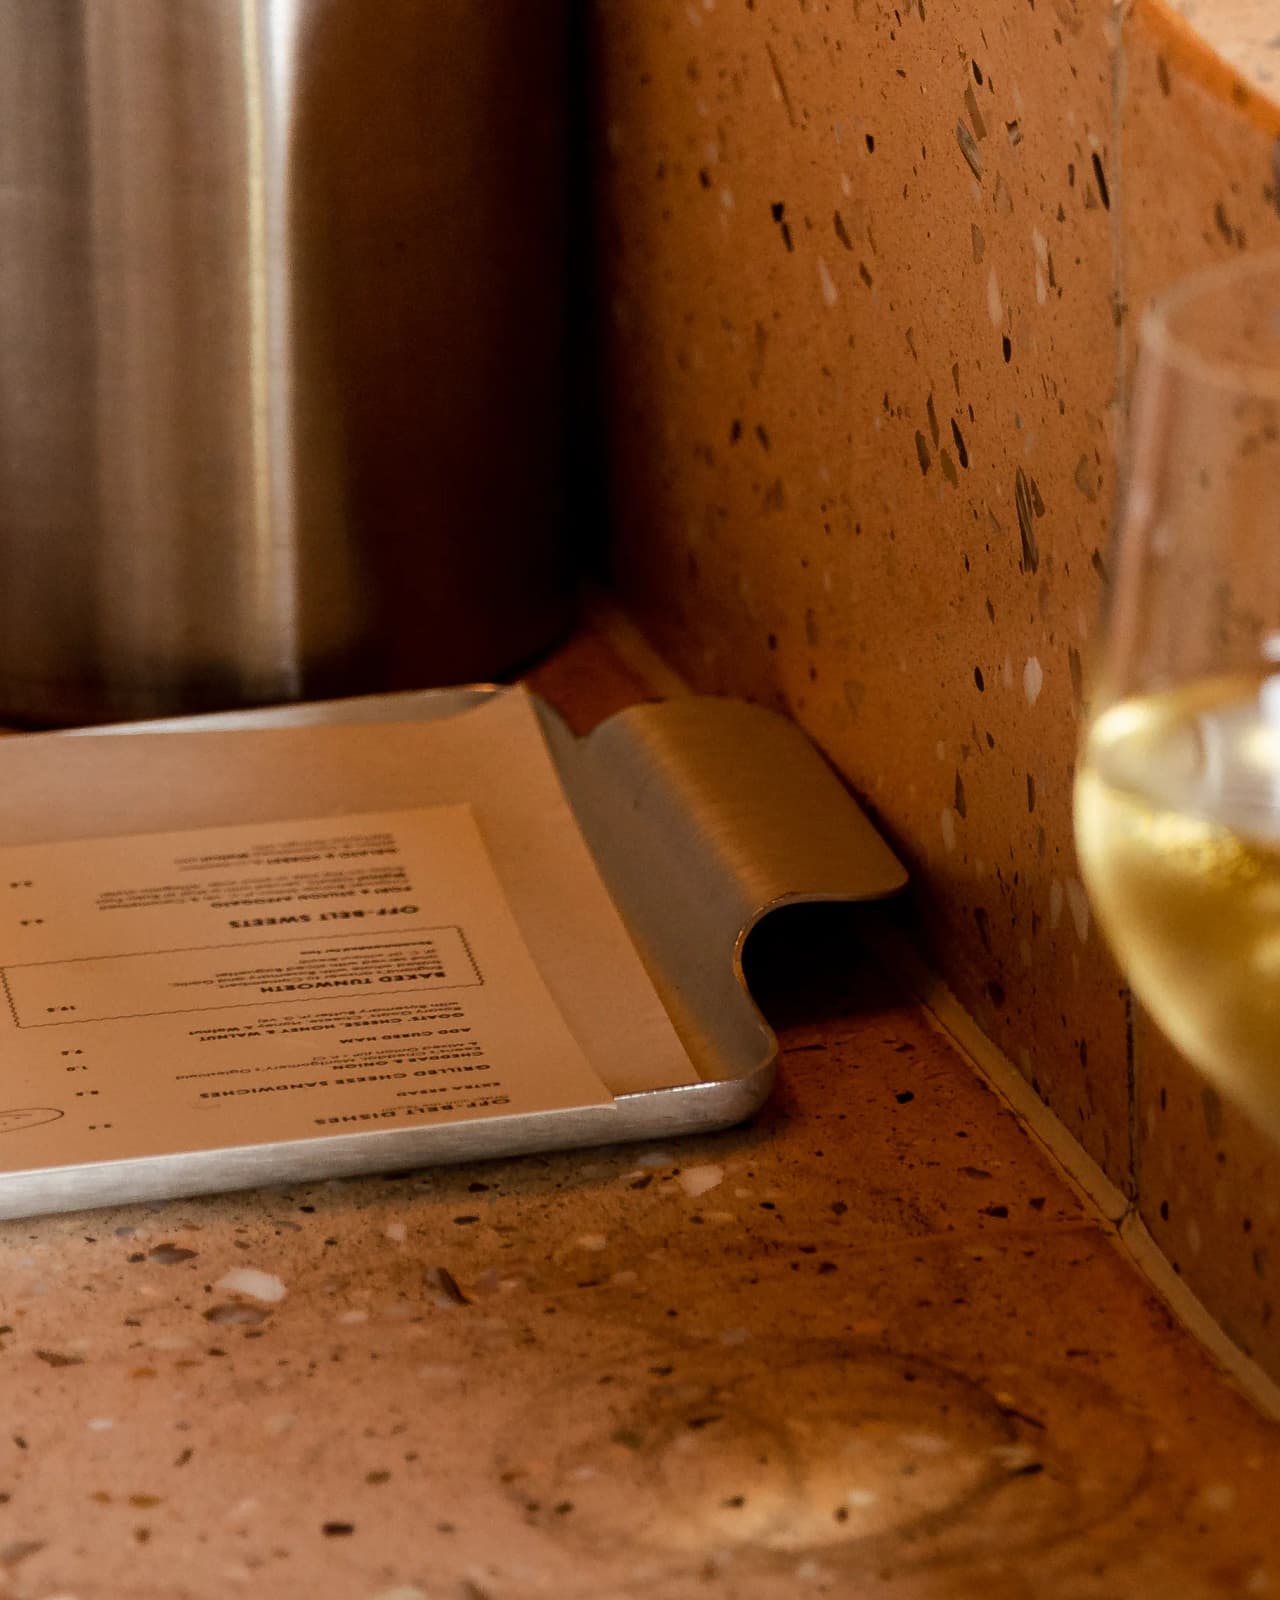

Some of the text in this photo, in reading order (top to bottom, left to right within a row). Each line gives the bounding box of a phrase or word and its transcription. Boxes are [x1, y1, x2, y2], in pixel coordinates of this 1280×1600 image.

[228, 905, 420, 928] OFF-BELT SWEETS
[259, 971, 446, 994] BAKED TUNWORTH
[187, 1027, 240, 1035] Walnut
[280, 1024, 335, 1033] HONEY
[198, 1031, 261, 1041] WALNUT
[380, 1031, 433, 1040] CURED
[407, 1051, 483, 1062] CHEDDAR
[331, 1060, 389, 1070] ONION
[199, 1064, 491, 1099] GRILLED CHEESE SANDWICHES
[404, 1098, 511, 1115] OFF-BELT
[313, 1111, 397, 1125] DISHES
